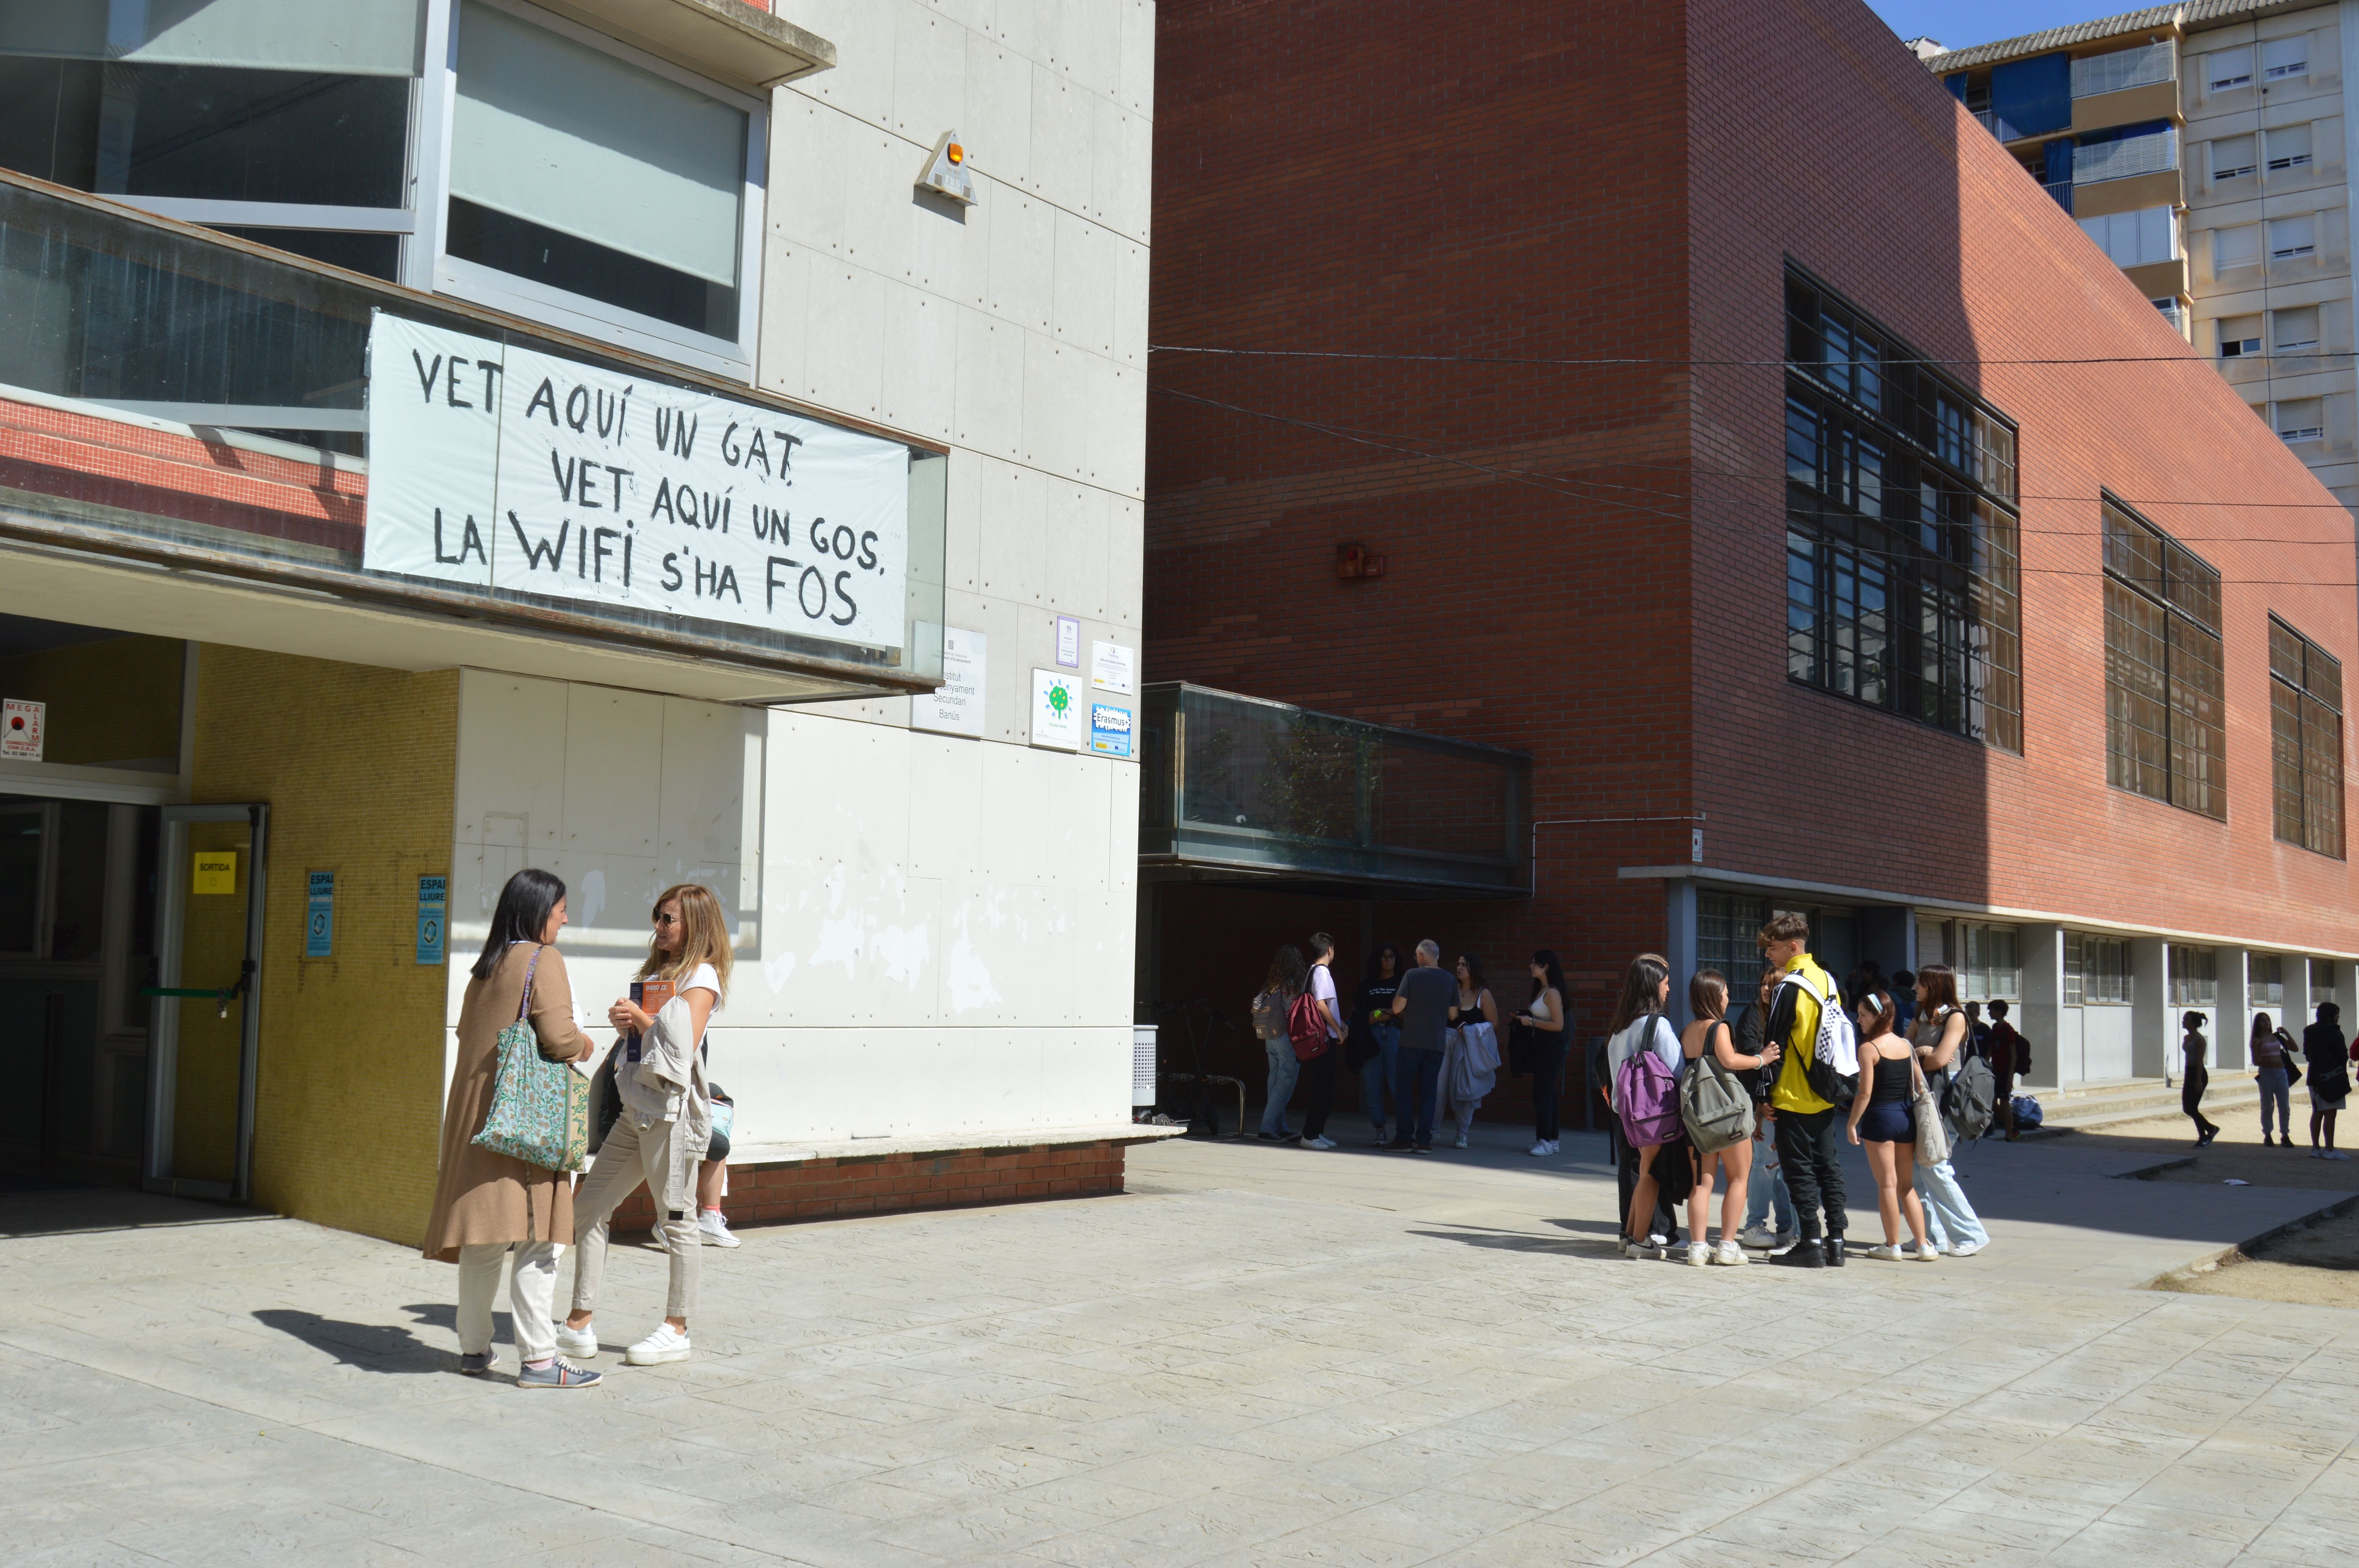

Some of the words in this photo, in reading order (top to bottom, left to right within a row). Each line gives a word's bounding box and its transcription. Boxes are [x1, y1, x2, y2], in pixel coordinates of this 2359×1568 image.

[412, 348, 503, 414] VET
[525, 376, 633, 446] AQUÍ
[656, 407, 698, 460] UN
[551, 448, 634, 512] VET
[651, 477, 733, 534] AQUÍ
[752, 504, 790, 546] UN
[434, 507, 487, 565] LA
[767, 555, 857, 626] FOS
[943, 671, 961, 682] nstitut
[934, 692, 966, 706] Secundari
[939, 709, 960, 720] Banús
[1097, 713, 1128, 726] Erasmus+
[311, 875, 333, 884] ESPAI
[420, 879, 445, 889] ESPAI
